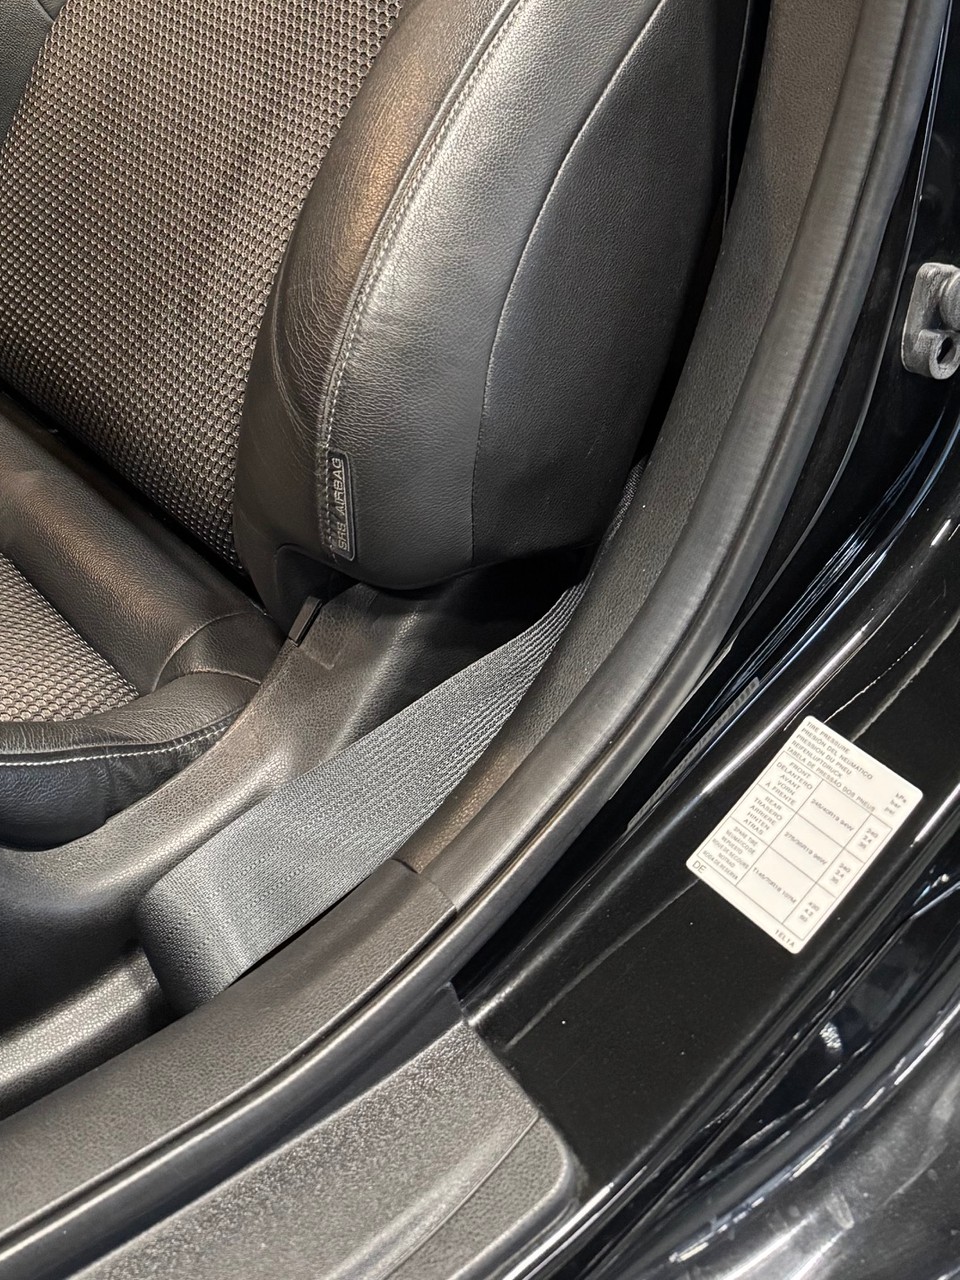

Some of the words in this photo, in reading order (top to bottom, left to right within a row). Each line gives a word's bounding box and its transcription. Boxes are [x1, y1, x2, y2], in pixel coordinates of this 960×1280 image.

[331, 457, 346, 516] AIRBAG
[337, 522, 348, 551] SRS
[806, 722, 820, 732] TIRE
[819, 731, 850, 754] PRESSURE
[791, 740, 843, 778] REIFENLUFTDRUCK
[796, 734, 825, 756] PRESSION
[826, 755, 835, 763] DU
[835, 762, 852, 775] PNEU
[826, 746, 839, 756] DEL
[776, 762, 813, 790] DELANTERO
[787, 747, 807, 762] TABELA
[807, 761, 815, 769] DE
[842, 787, 856, 797] DOS
[856, 797, 875, 811] PNEUS
[789, 762, 811, 779] FRONT
[777, 781, 795, 795] VORN
[780, 774, 800, 790] AVANT
[765, 796, 782, 811] REAR
[772, 786, 796, 806] FRENTE
[890, 800, 901, 809] bar
[895, 793, 908, 803] kPa
[754, 798, 783, 821] TRASERO
[747, 812, 770, 830] HINTEN
[734, 827, 747, 838] SPARE
[747, 837, 757, 846] TIRE
[692, 860, 706, 873] DE
